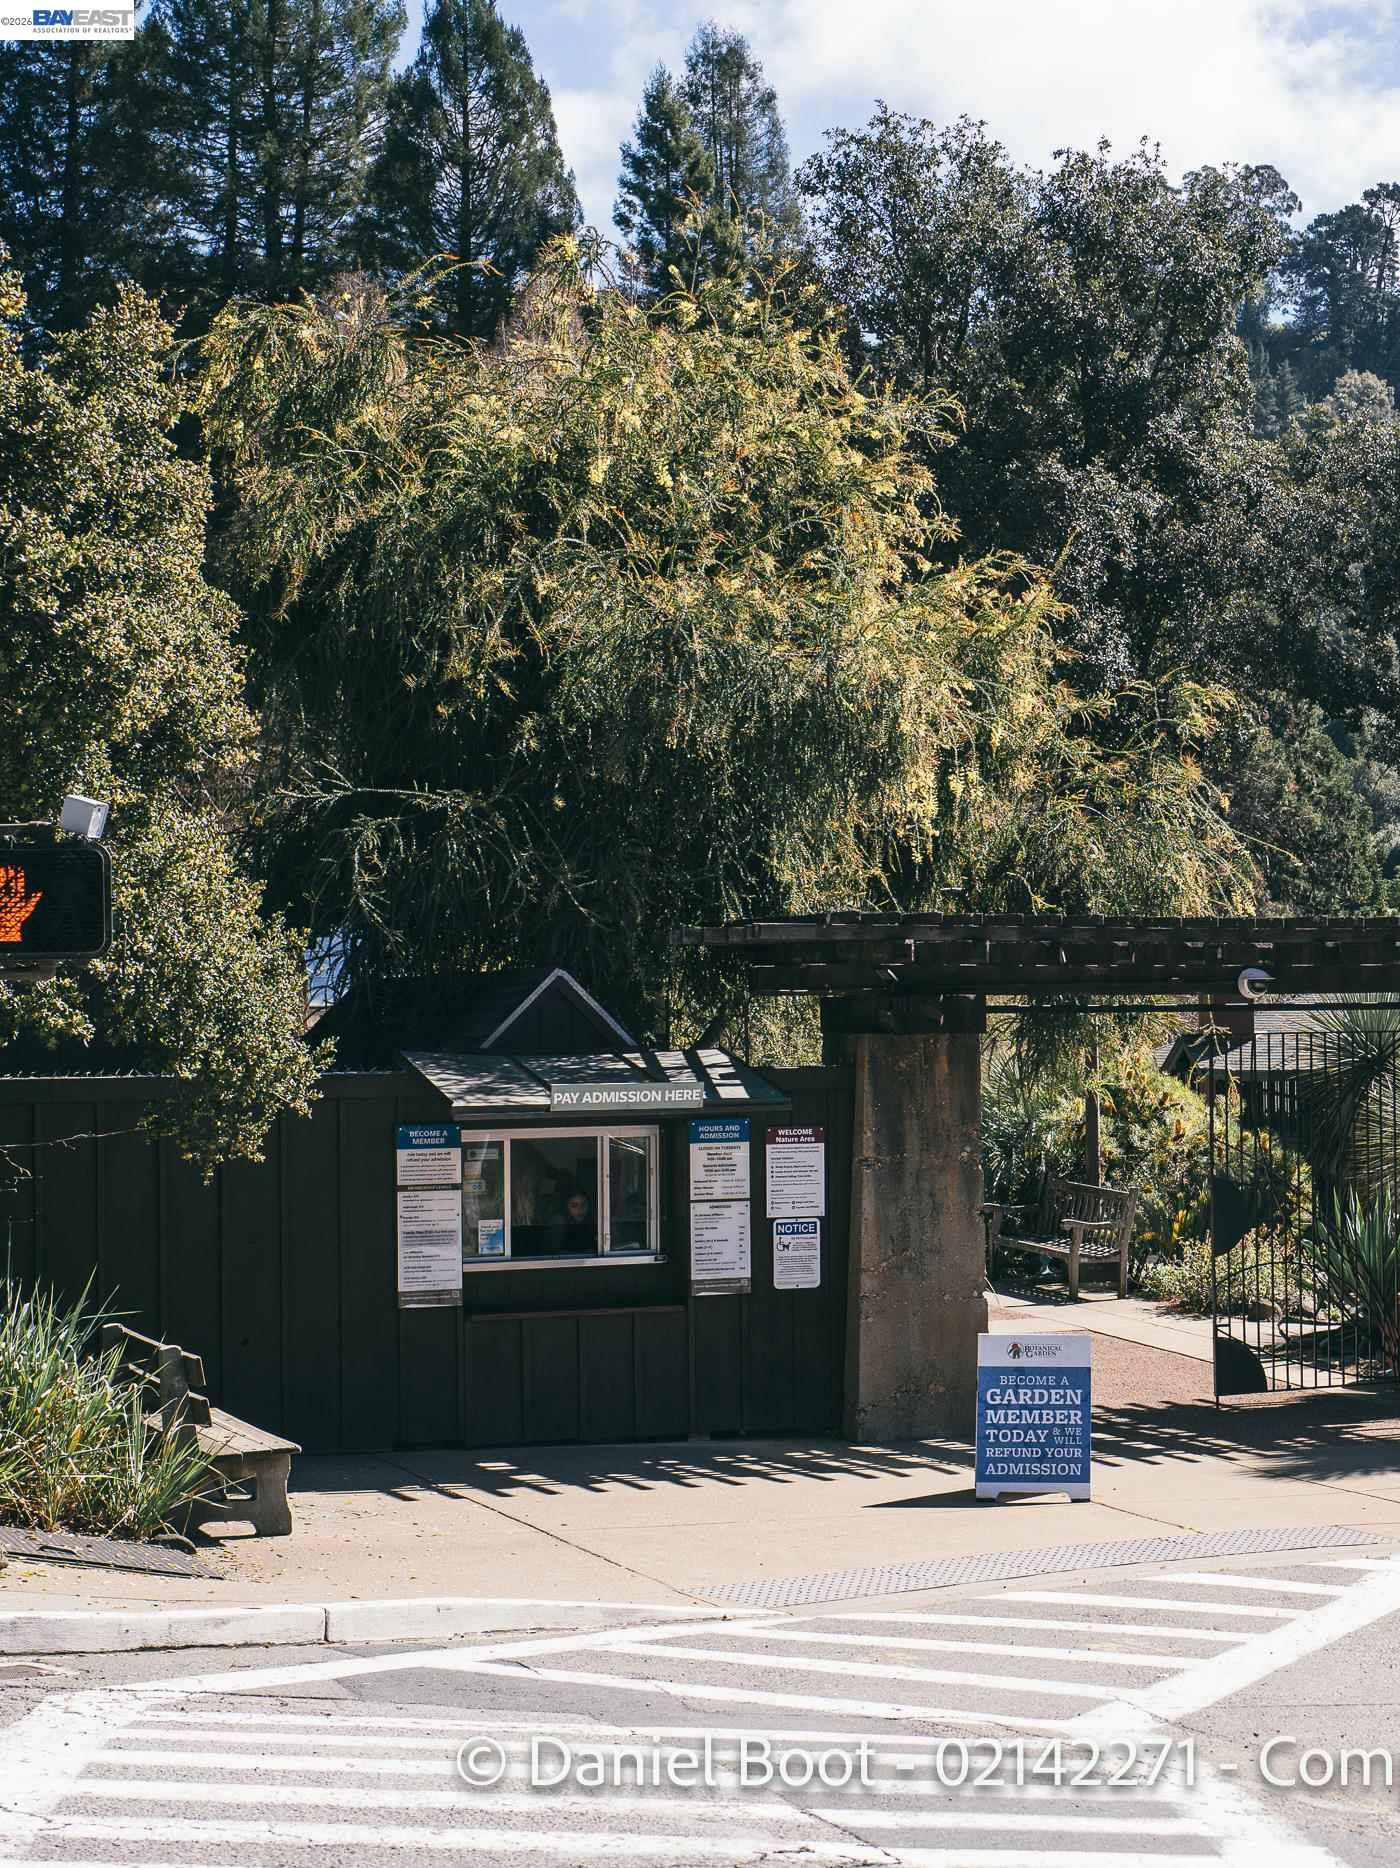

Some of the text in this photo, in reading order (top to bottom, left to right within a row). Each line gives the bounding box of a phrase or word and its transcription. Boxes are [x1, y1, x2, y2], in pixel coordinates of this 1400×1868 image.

[553, 1088, 702, 1105] PAY ADMISSION HERE
[699, 1124, 741, 1133] HOURS AND
[778, 1128, 813, 1136] WELCOME
[409, 1130, 441, 1138] BECOME
[412, 1137, 445, 1145] MEMBER
[777, 1223, 815, 1234] NOTICE
[1000, 1375, 1069, 1385] BECOME A
[986, 1388, 1082, 1405] GARDEN
[985, 1410, 1083, 1425] MEMBER
[986, 1428, 1082, 1443] TODAY & WE
[1054, 1437, 1082, 1445] WILL
[985, 1448, 1082, 1458] REFUND YOUR
[985, 1463, 1083, 1475] ADMISSION
